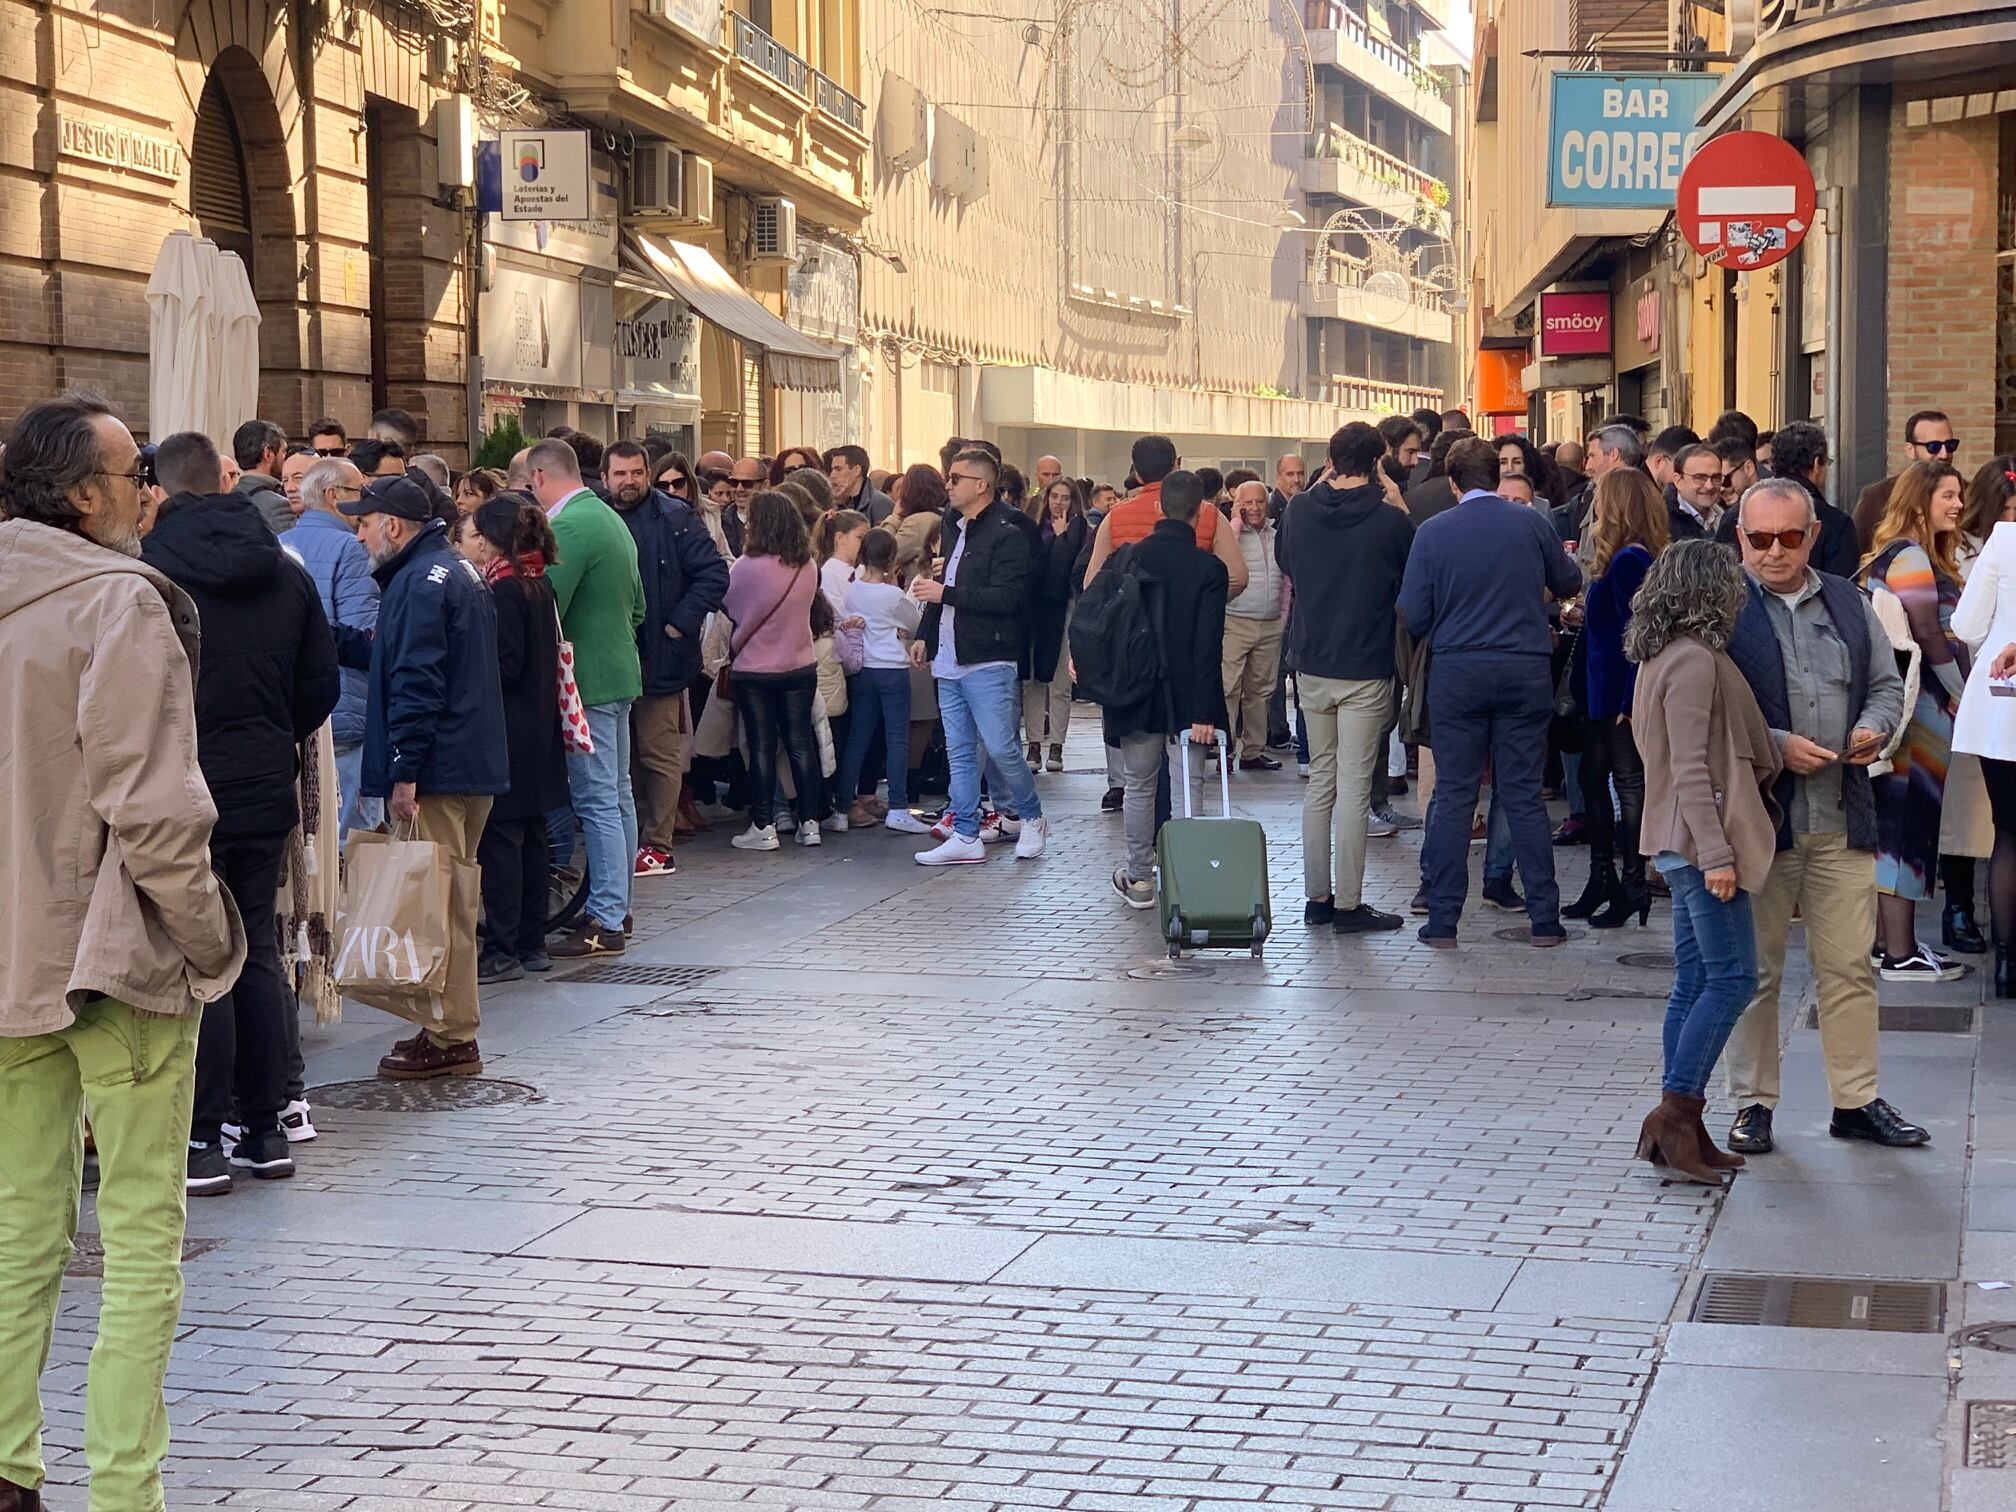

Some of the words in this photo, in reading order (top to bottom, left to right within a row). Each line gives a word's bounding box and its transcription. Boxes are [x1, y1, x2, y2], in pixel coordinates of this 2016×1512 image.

[1603, 89, 1669, 118] BAR
[514, 195, 553, 205] Apuestas
[555, 194, 568, 202] del
[514, 205, 543, 213] Estado
[1545, 312, 1604, 333] smöoy
[334, 926, 422, 984] ZARA
